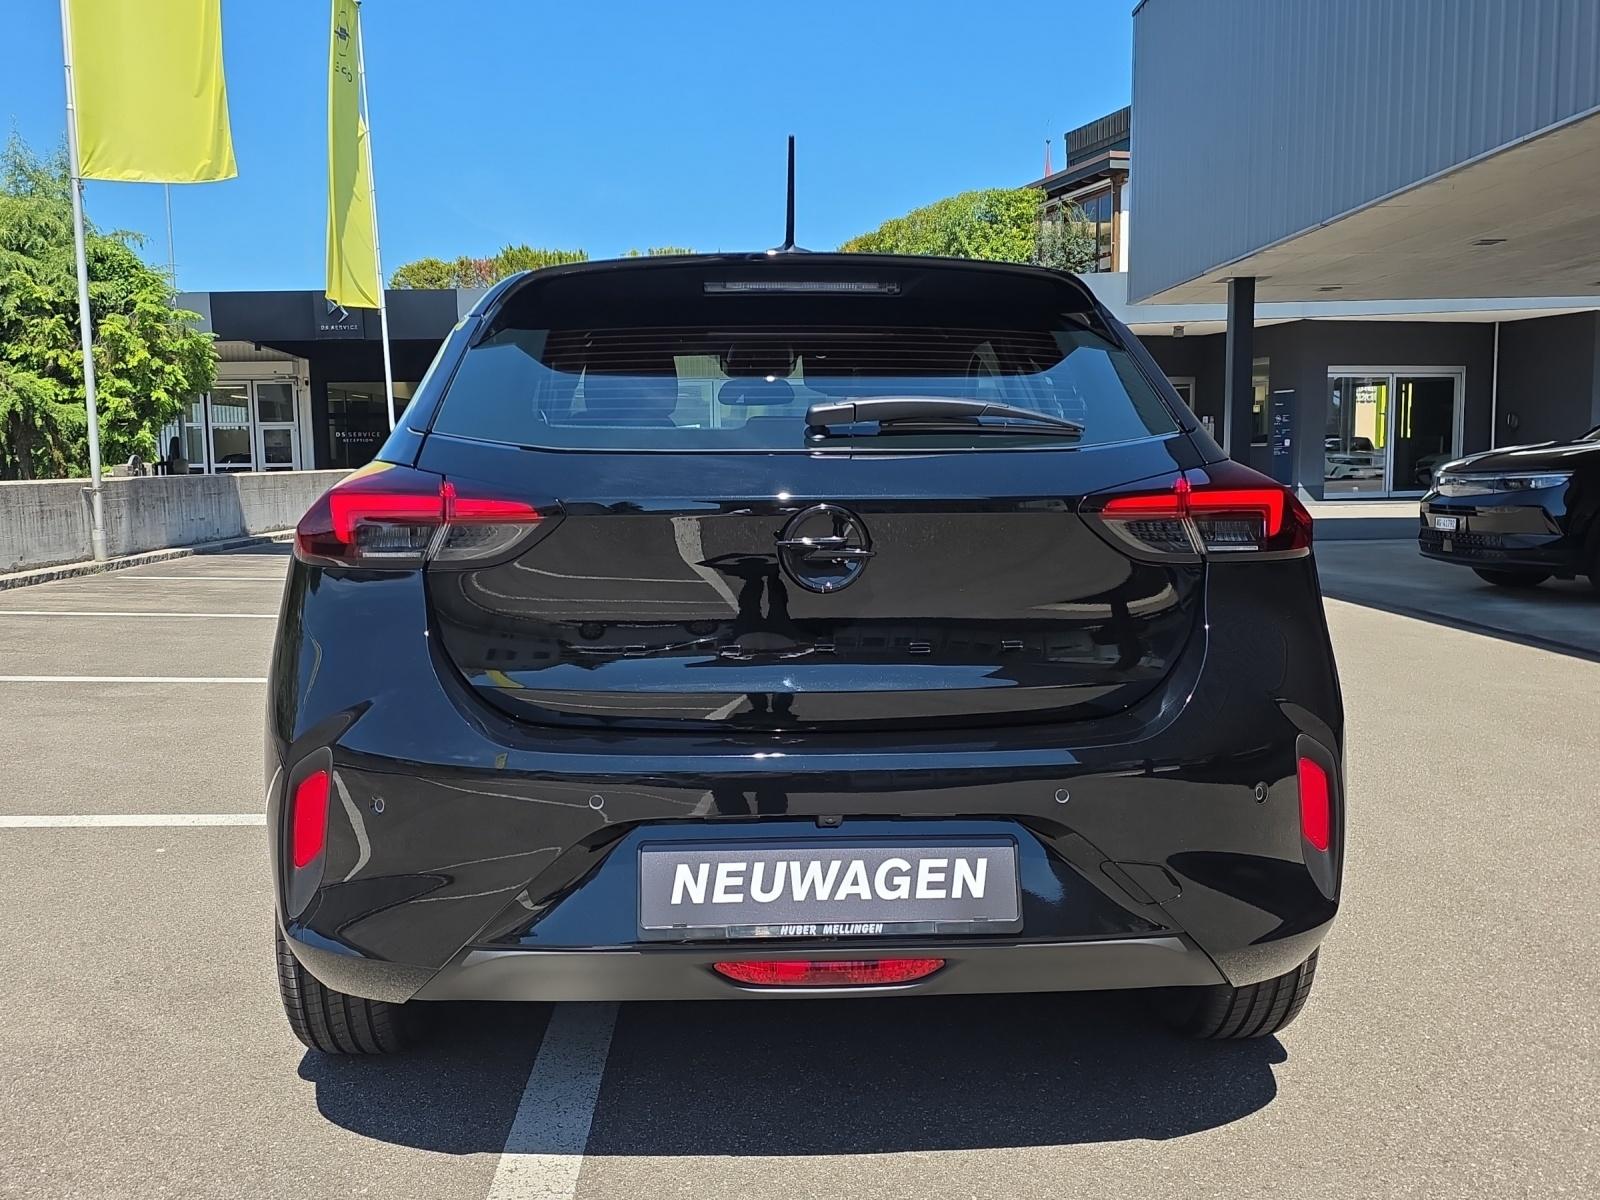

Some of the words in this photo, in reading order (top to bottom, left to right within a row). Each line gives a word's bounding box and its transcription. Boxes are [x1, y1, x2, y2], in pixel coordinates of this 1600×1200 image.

[670, 857, 988, 905] NEUWAGEN
[780, 924, 817, 936] HUBER
[822, 923, 883, 935] MELLINGEN
